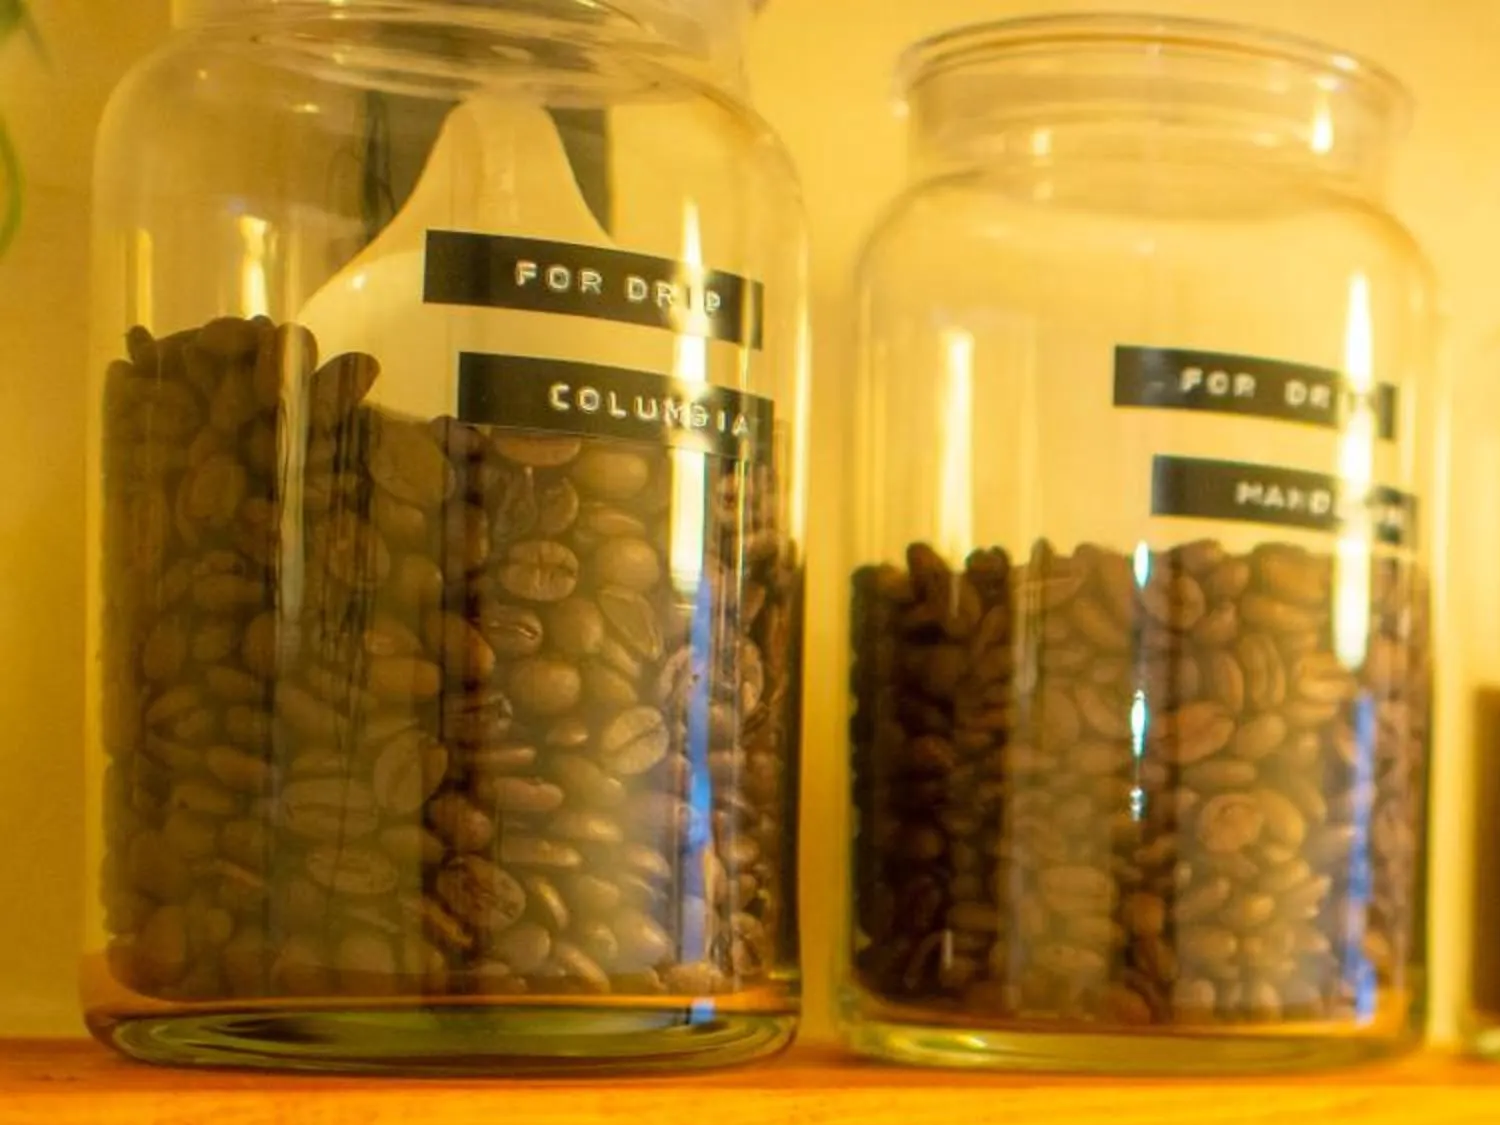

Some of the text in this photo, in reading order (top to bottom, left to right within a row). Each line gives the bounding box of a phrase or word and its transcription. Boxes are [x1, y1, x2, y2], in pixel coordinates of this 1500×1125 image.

[514, 259, 722, 313] FOR DRP
[548, 382, 750, 437] COLUMBIA
[1179, 367, 1257, 399] FOR
